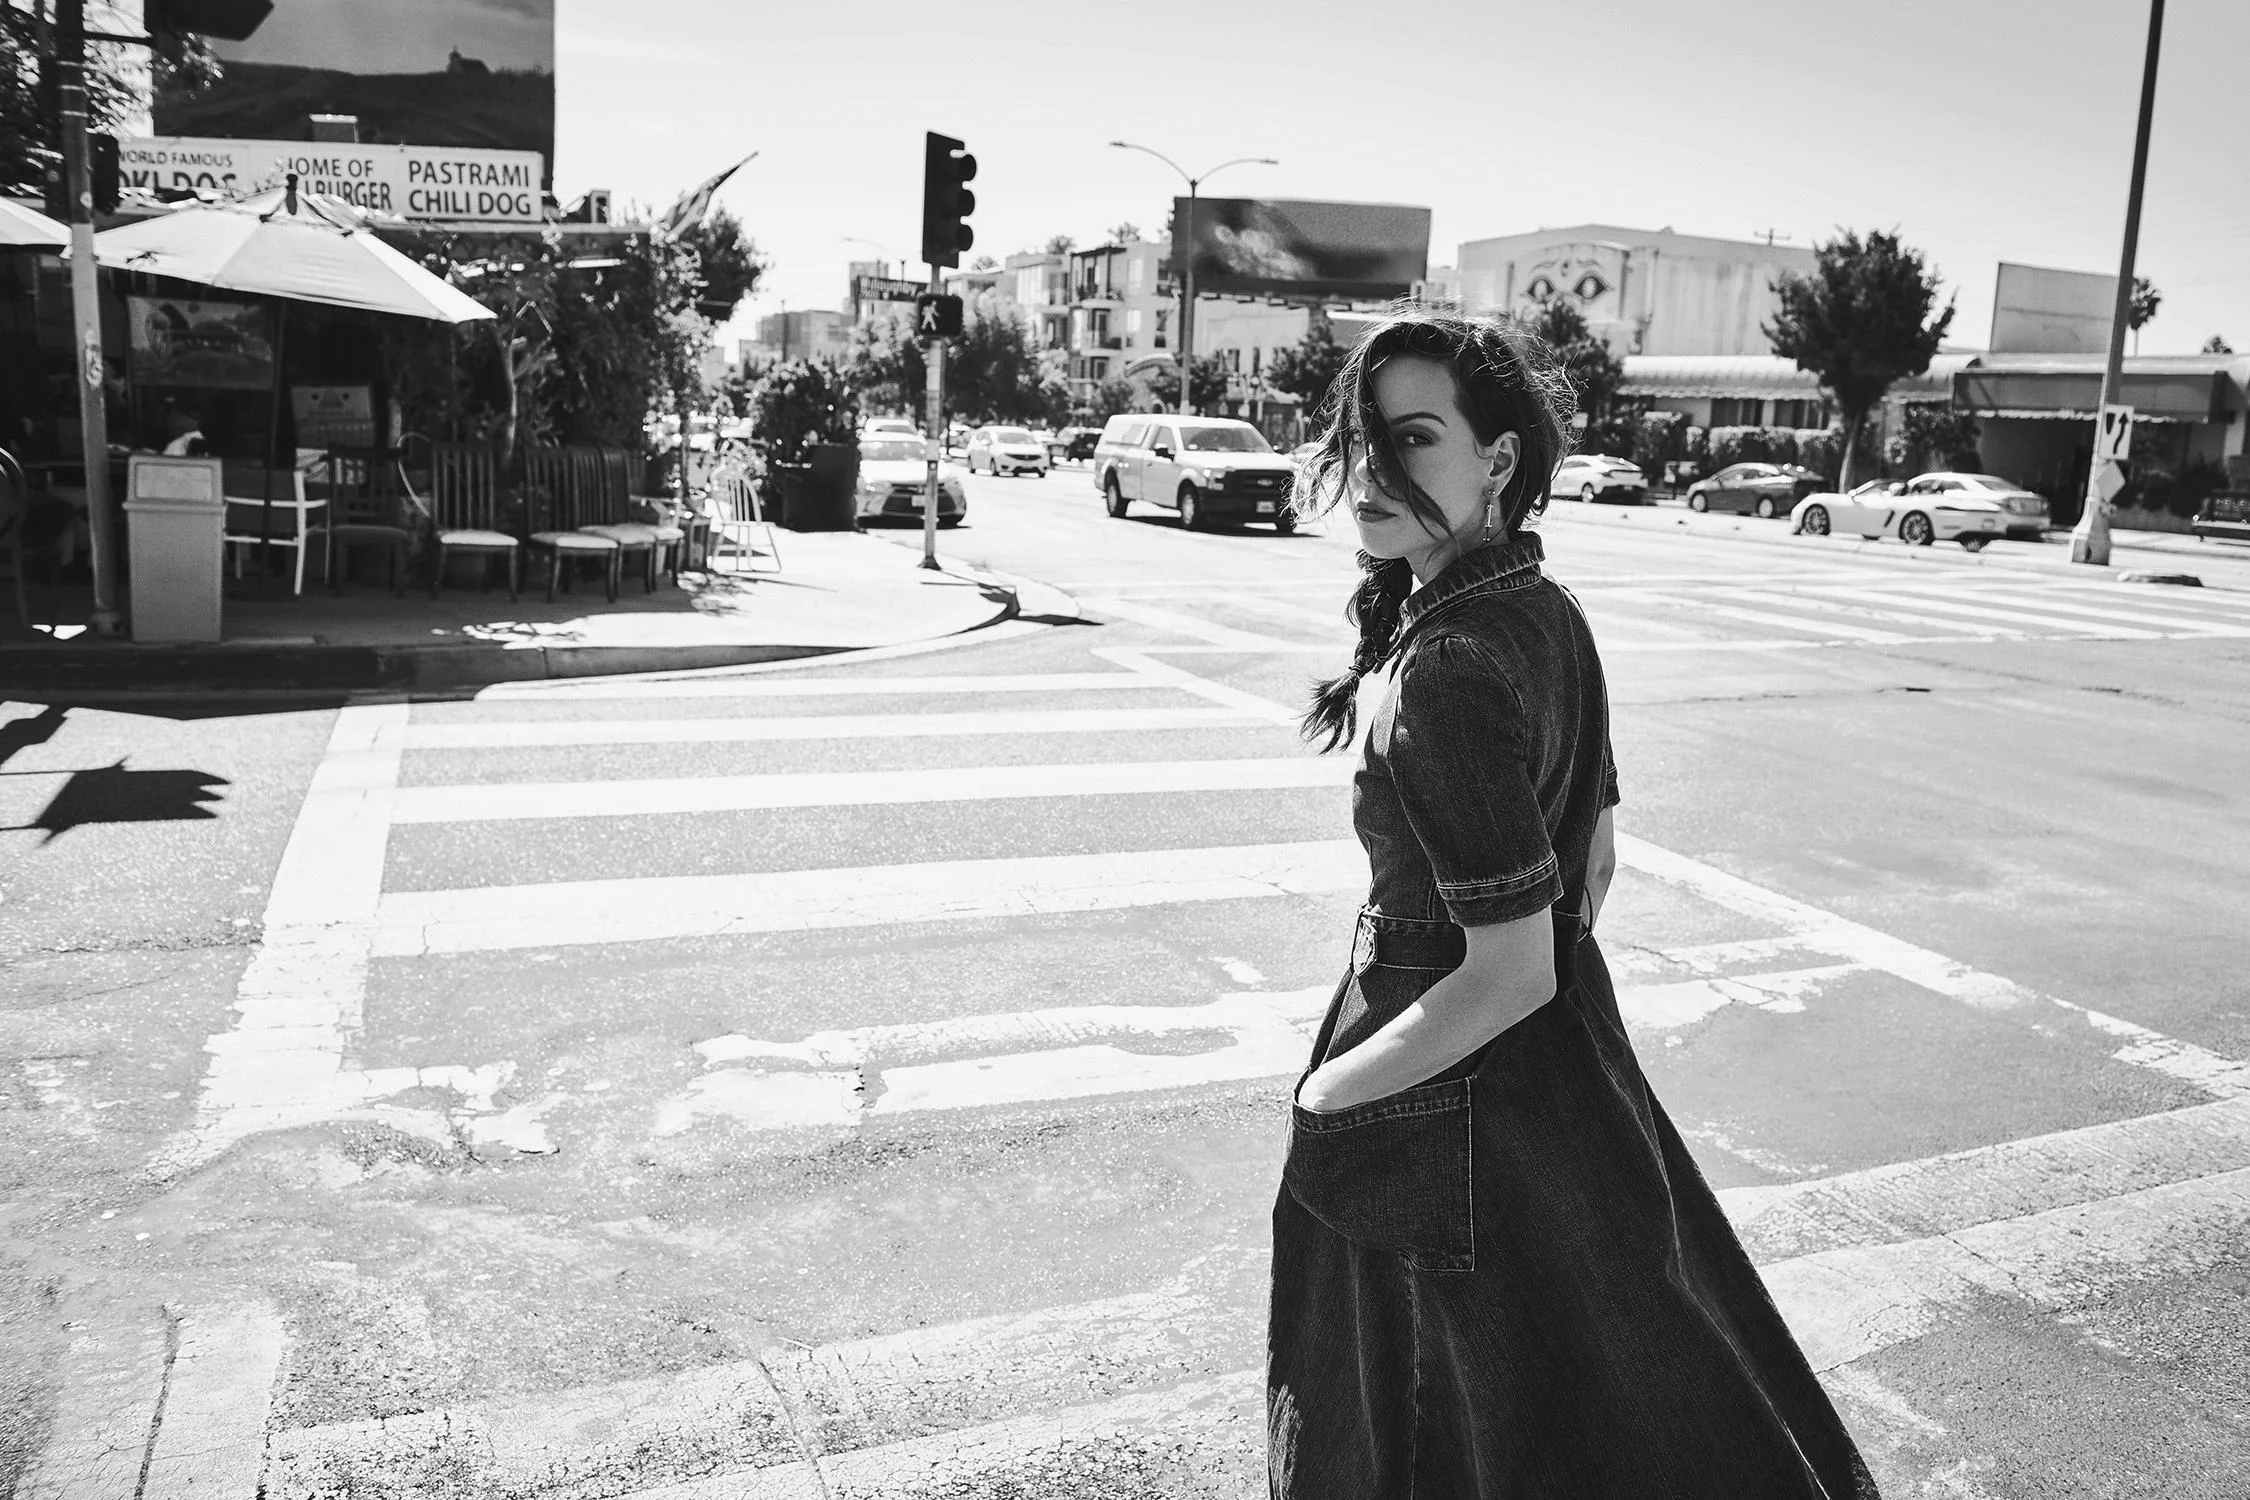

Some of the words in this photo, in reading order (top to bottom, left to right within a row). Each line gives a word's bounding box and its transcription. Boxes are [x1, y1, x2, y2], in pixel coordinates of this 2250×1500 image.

[172, 151, 233, 168] FAMOUS
[348, 159, 374, 178] OF
[408, 160, 529, 187] PASTRAMI
[408, 189, 470, 214] CHILI
[479, 192, 531, 216] DOG
